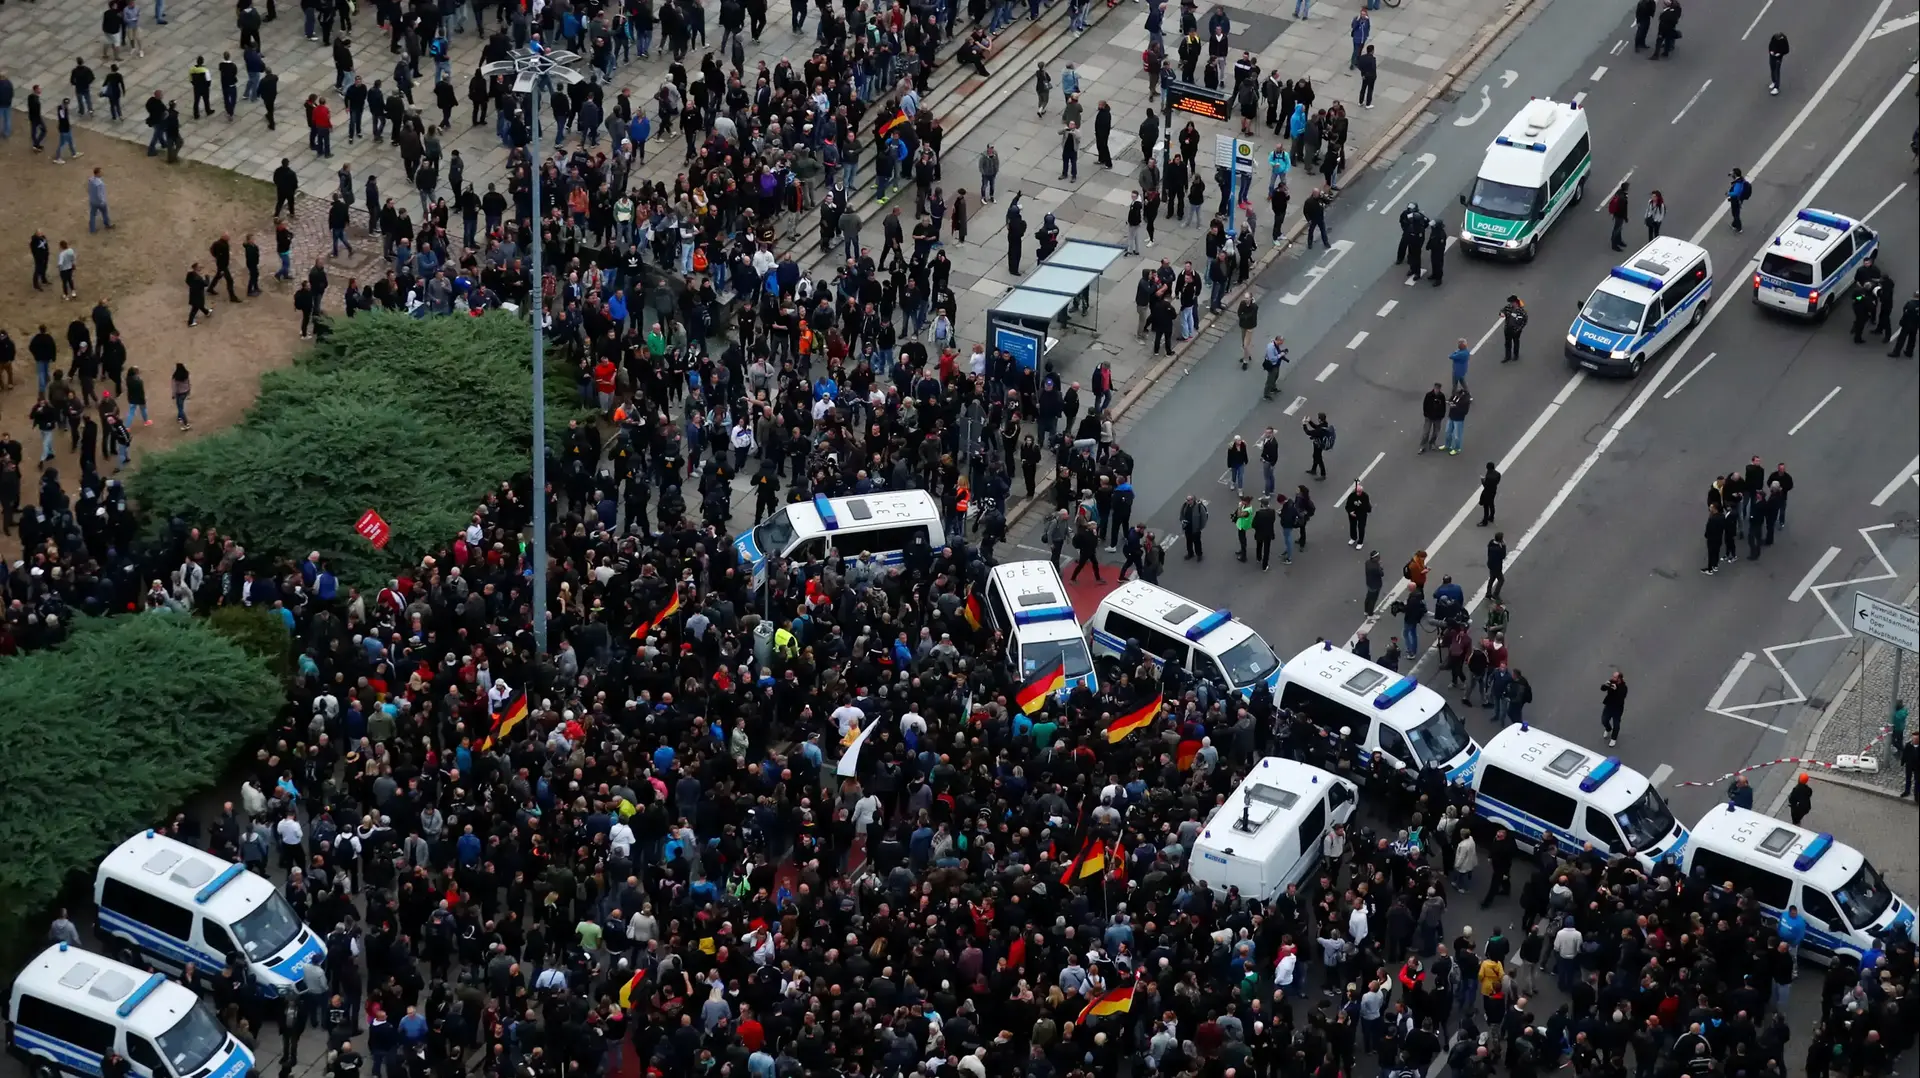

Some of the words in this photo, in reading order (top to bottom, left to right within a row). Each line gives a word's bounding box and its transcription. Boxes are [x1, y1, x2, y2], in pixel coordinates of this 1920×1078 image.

[1477, 222, 1507, 233] POLIZEI
[1583, 331, 1612, 345] POLIZEI
[1869, 618, 1885, 629] Oper
[1868, 627, 1913, 647] Hauptbahnhof
